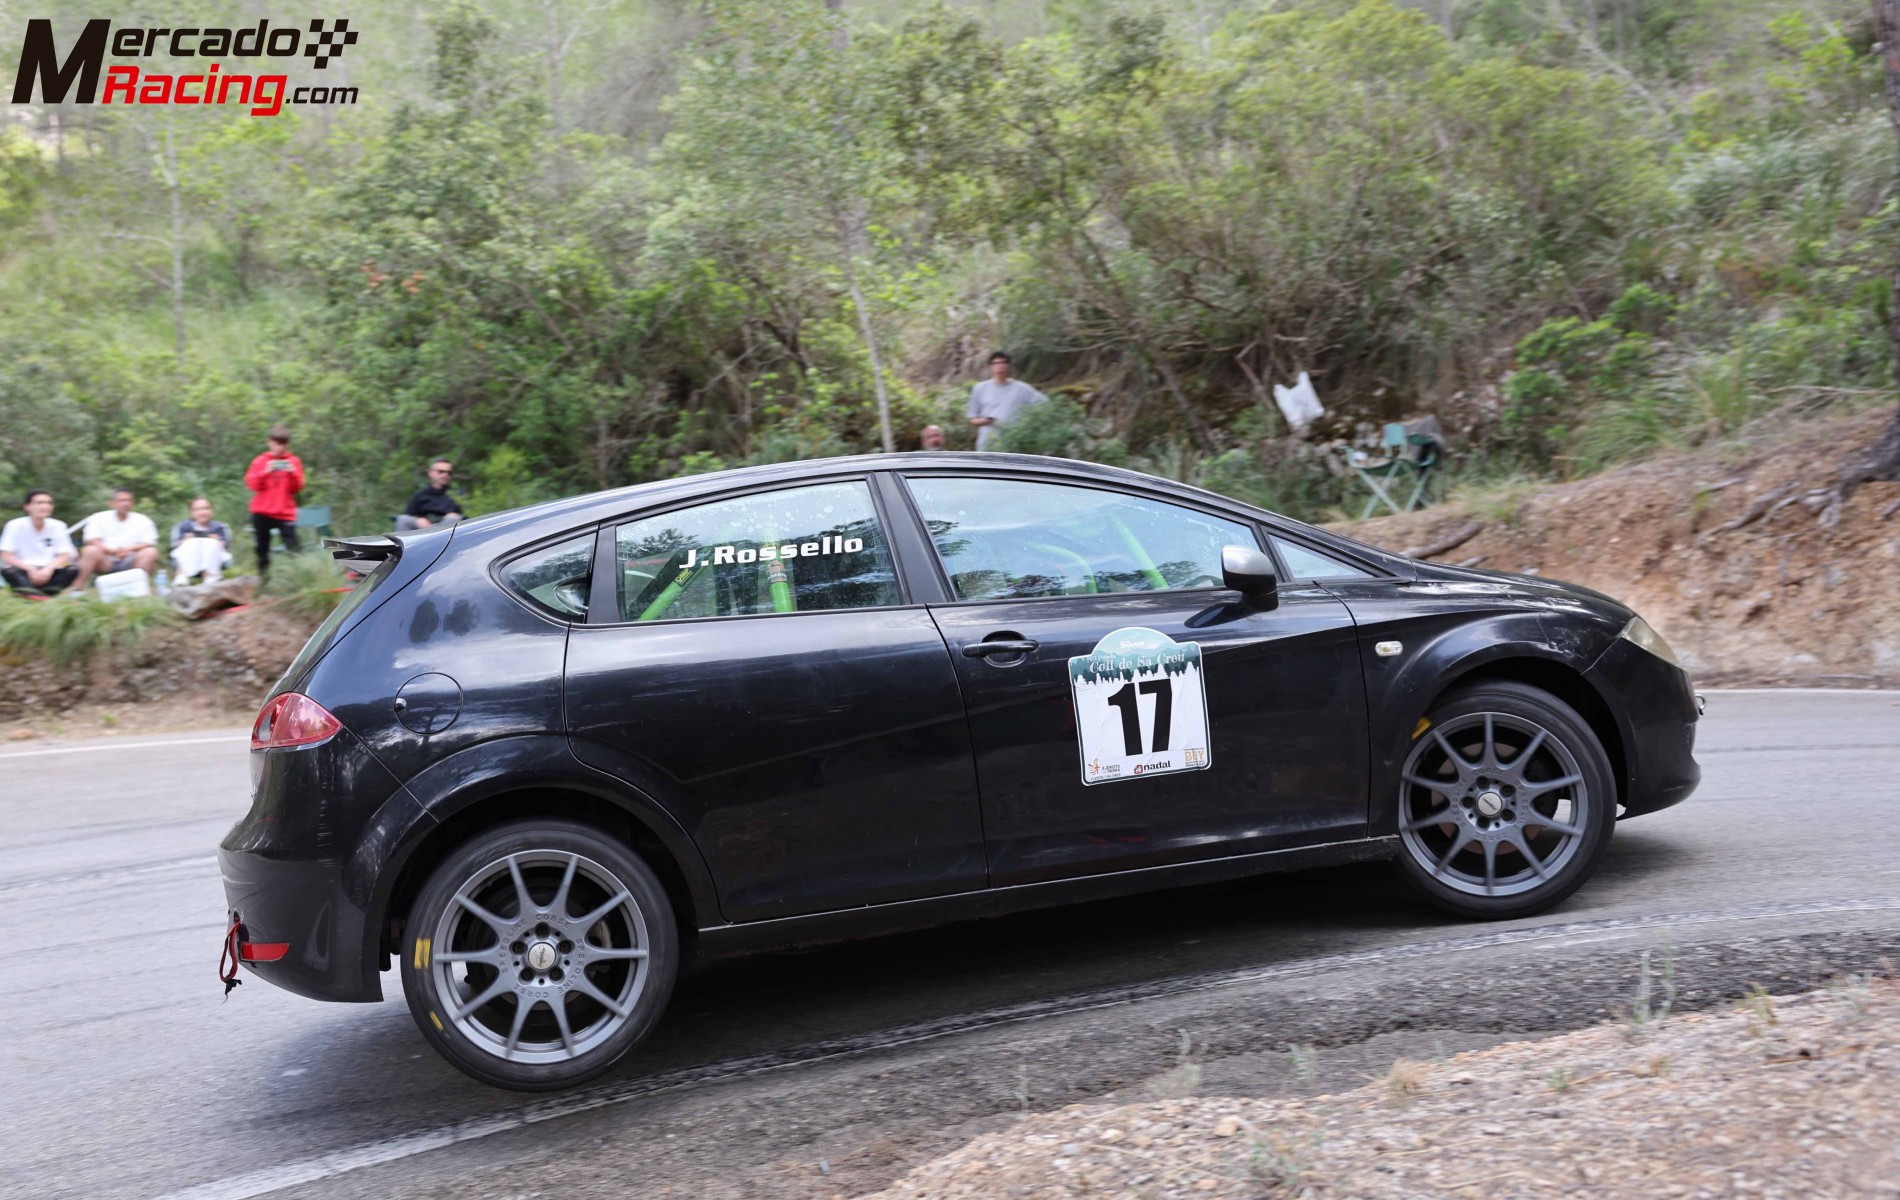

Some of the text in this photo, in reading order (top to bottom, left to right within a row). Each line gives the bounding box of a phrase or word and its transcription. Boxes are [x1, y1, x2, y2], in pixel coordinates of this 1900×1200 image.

[1089, 652, 1185, 674] Coll de Sa Creu
[1107, 678, 1172, 756] 17
[1143, 760, 1171, 771] nadal
[535, 914, 571, 929] CORSE
